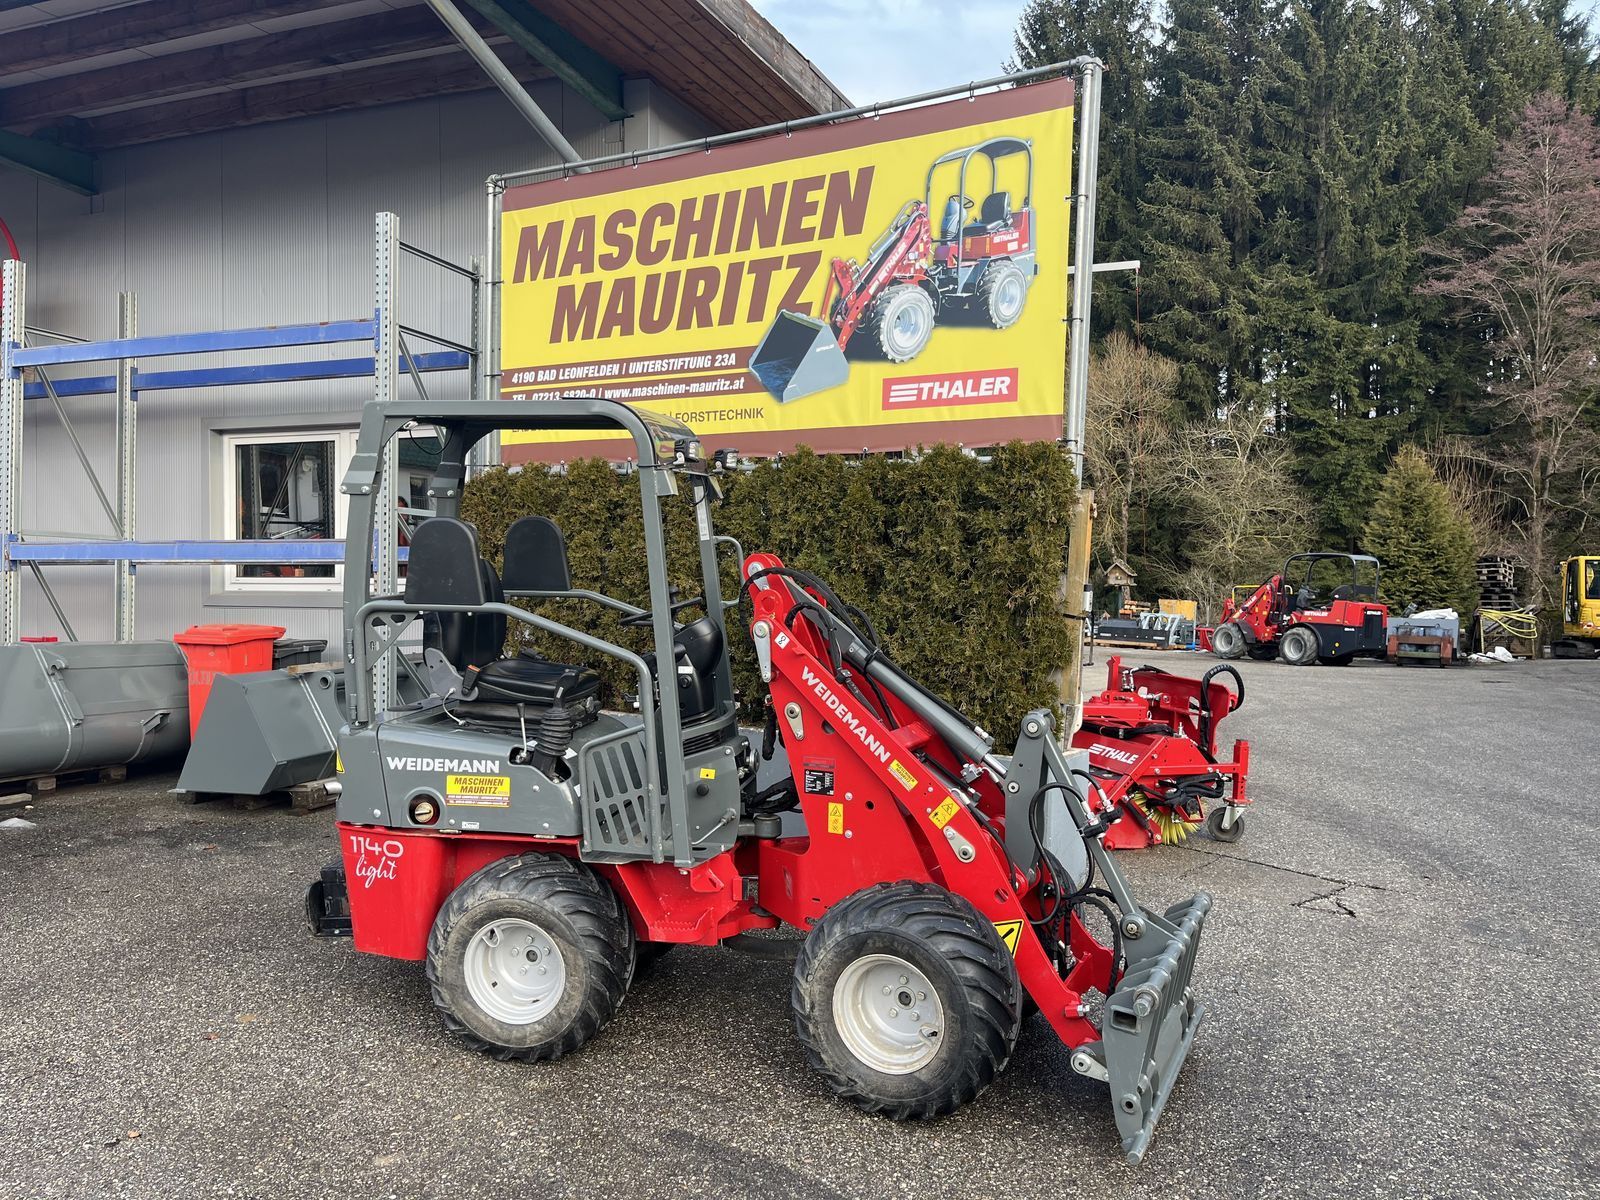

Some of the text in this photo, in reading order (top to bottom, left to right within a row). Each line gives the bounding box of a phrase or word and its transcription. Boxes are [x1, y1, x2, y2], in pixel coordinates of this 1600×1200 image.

[512, 165, 875, 284] MASCHINEN
[549, 250, 823, 344] MAURITZ
[511, 370, 535, 384] 4190
[537, 370, 557, 382] BAD
[559, 363, 619, 380] LEONFELDEN
[628, 355, 712, 374] UNTERSTIFTUNG
[714, 353, 736, 366] 23A
[604, 376, 745, 399] www.maschinen-mauritz.at
[918, 376, 1011, 401] THALER
[675, 408, 764, 423] FORSTTECHNIK
[801, 665, 891, 764] WEIDEMANN
[386, 756, 500, 773] WEIDEMANN
[454, 777, 504, 786] MASCHINEN
[459, 785, 498, 794] MAURITZ
[350, 835, 404, 858] 1140
[355, 853, 397, 888] light
